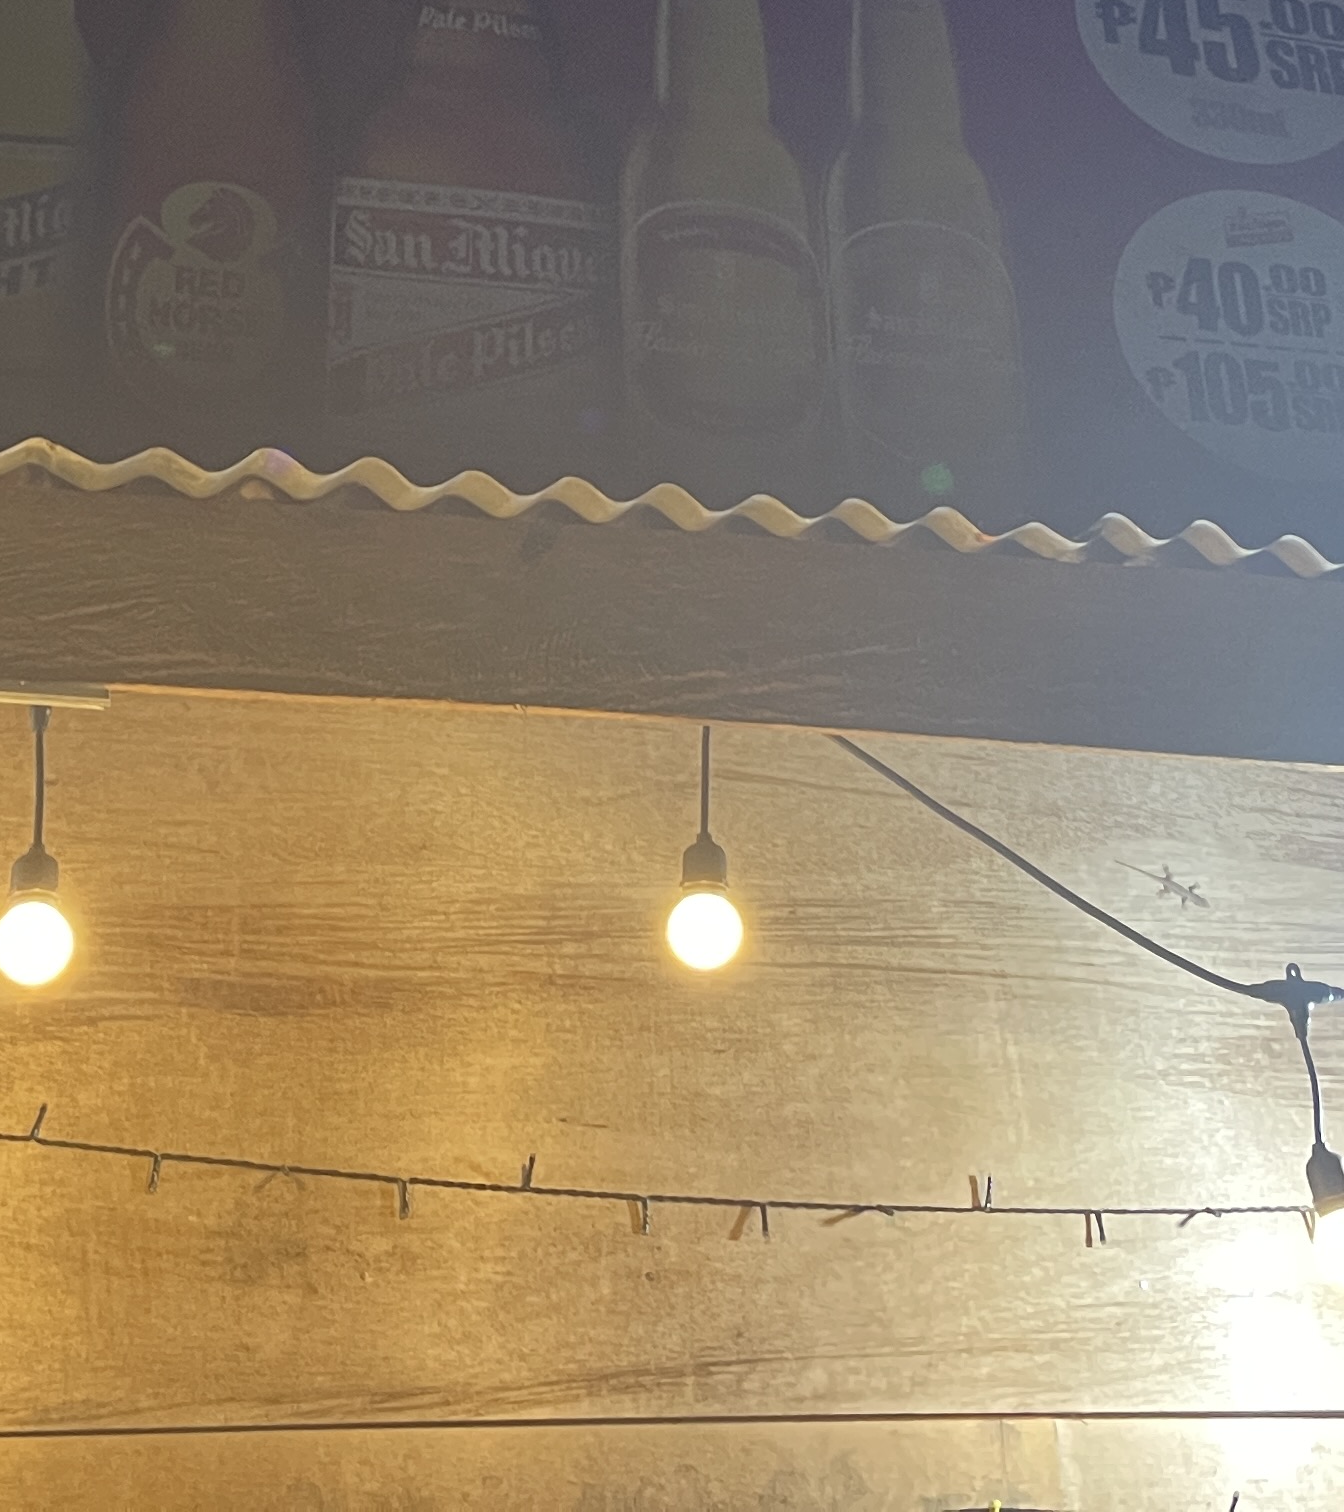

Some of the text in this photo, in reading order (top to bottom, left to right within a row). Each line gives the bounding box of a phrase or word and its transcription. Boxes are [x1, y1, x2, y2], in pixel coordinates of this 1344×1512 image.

[344, 209, 437, 270] San
[175, 265, 246, 299] RED
[1267, 297, 1331, 338] SRP
